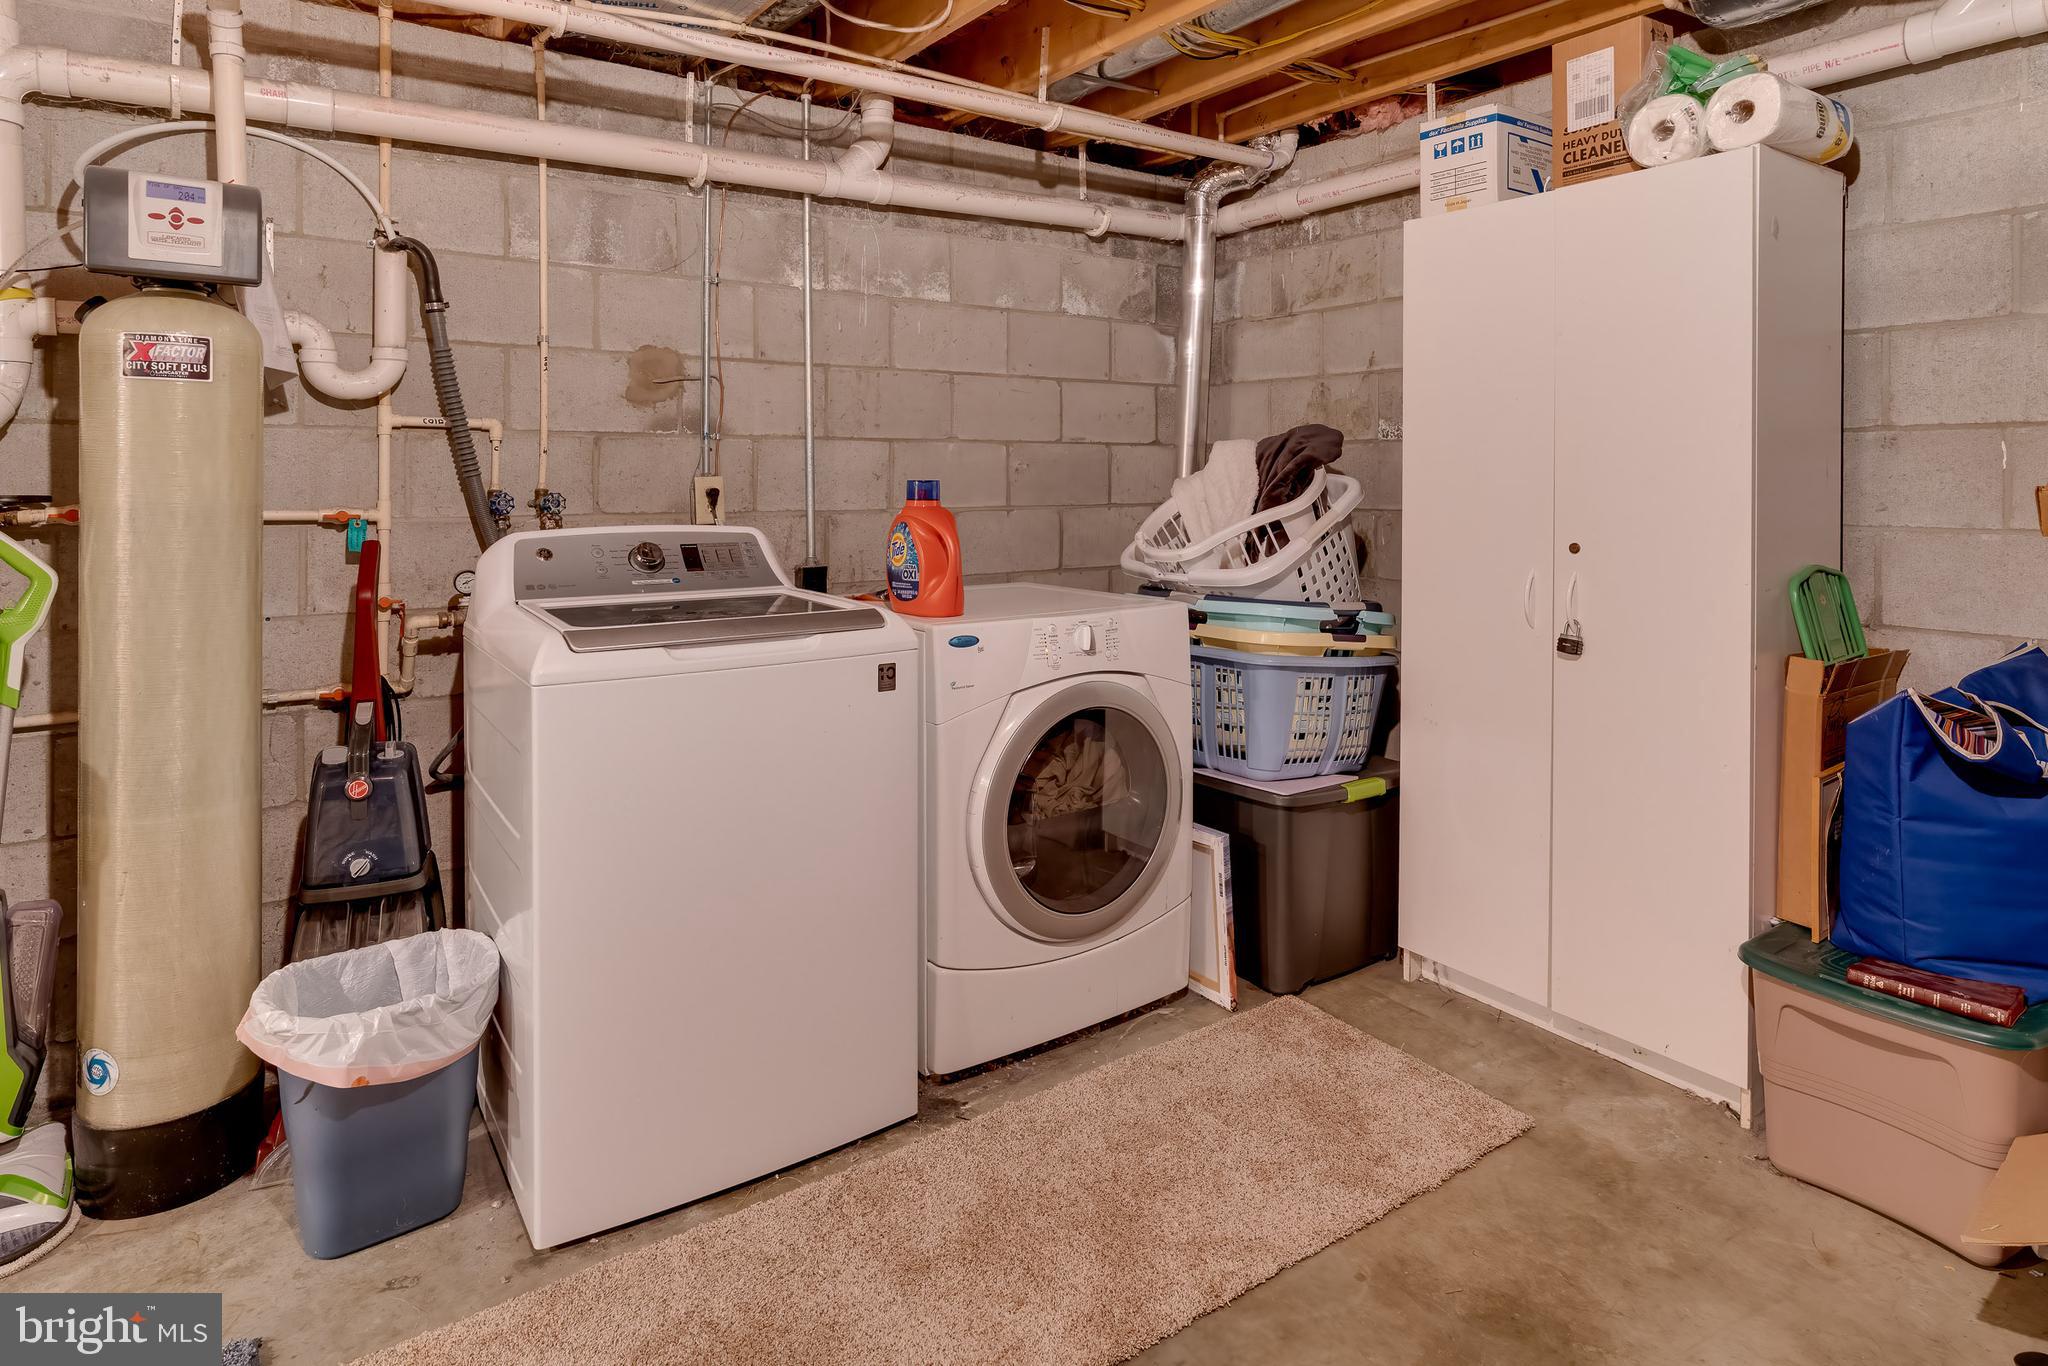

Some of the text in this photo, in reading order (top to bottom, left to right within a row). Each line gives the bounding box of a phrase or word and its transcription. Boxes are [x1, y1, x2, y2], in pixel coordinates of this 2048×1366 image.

[1802, 63, 1822, 74] PIPE
[1824, 59, 1841, 69] N/E
[1815, 98, 1826, 139] ounty
[1562, 132, 1600, 150] HEAVY
[1601, 128, 1624, 141] DUT
[135, 334, 176, 342] DIAMON
[126, 361, 208, 373] CITY SOFT PLUS
[891, 541, 905, 560] Tide
[902, 569, 917, 580] OXI
